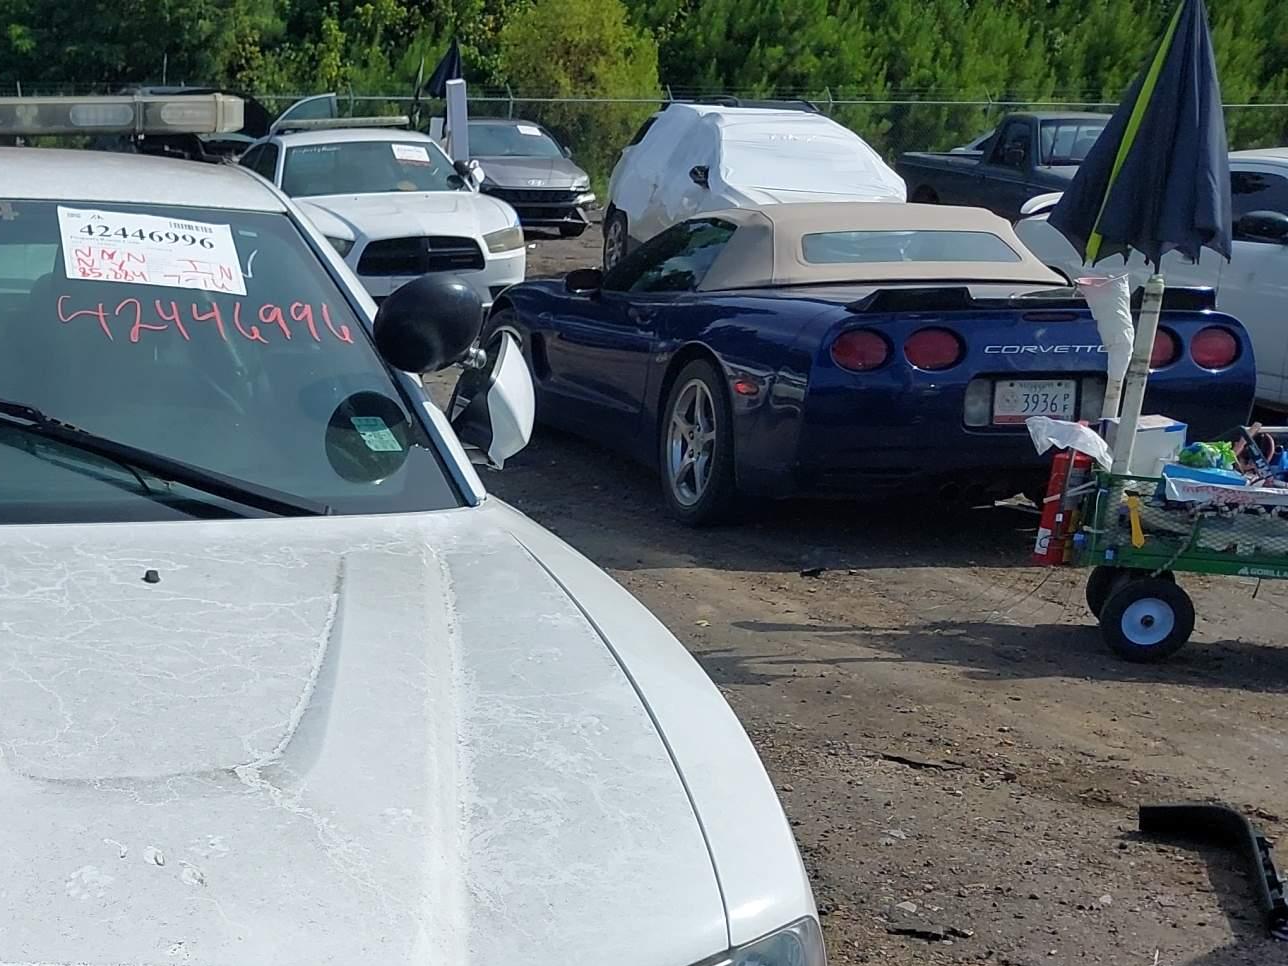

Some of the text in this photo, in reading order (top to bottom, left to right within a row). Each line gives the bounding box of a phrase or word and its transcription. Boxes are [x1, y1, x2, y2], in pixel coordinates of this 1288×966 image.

[79, 224, 214, 249] 42446996
[57, 294, 354, 344] 42446996
[1021, 393, 1058, 413] 3936
